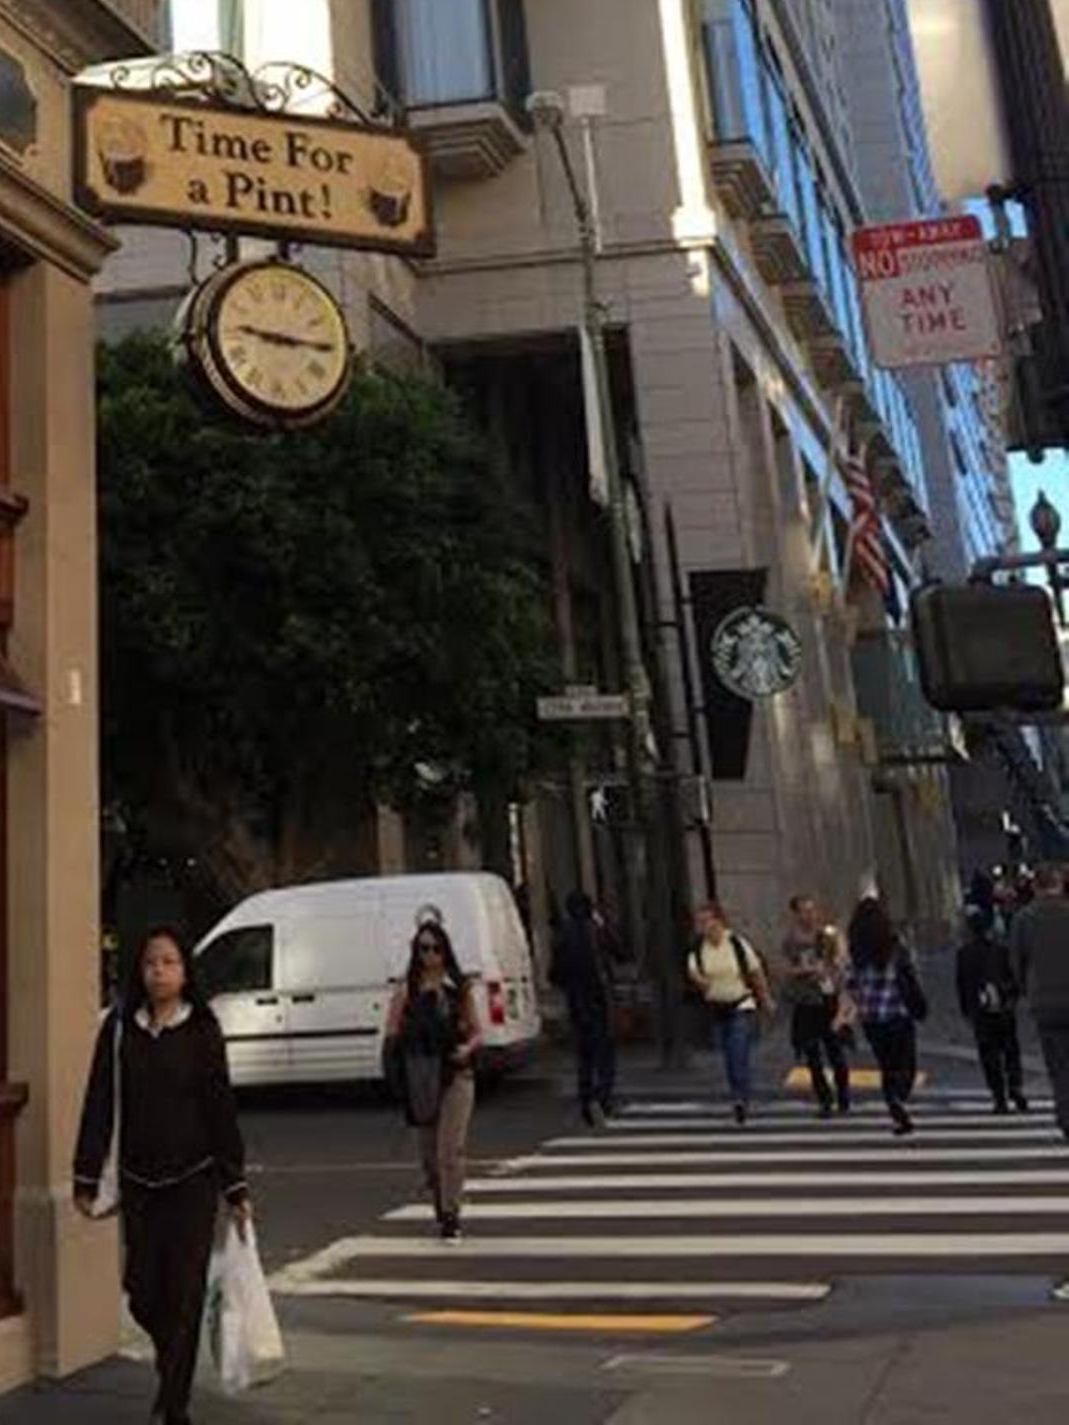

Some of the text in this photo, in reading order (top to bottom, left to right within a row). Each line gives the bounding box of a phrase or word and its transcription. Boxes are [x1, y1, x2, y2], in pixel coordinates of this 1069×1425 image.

[160, 115, 353, 175] Time For
[187, 172, 334, 219] a Pint!
[858, 247, 896, 277] NO
[901, 283, 953, 307] ANY
[900, 309, 966, 332] TIME
